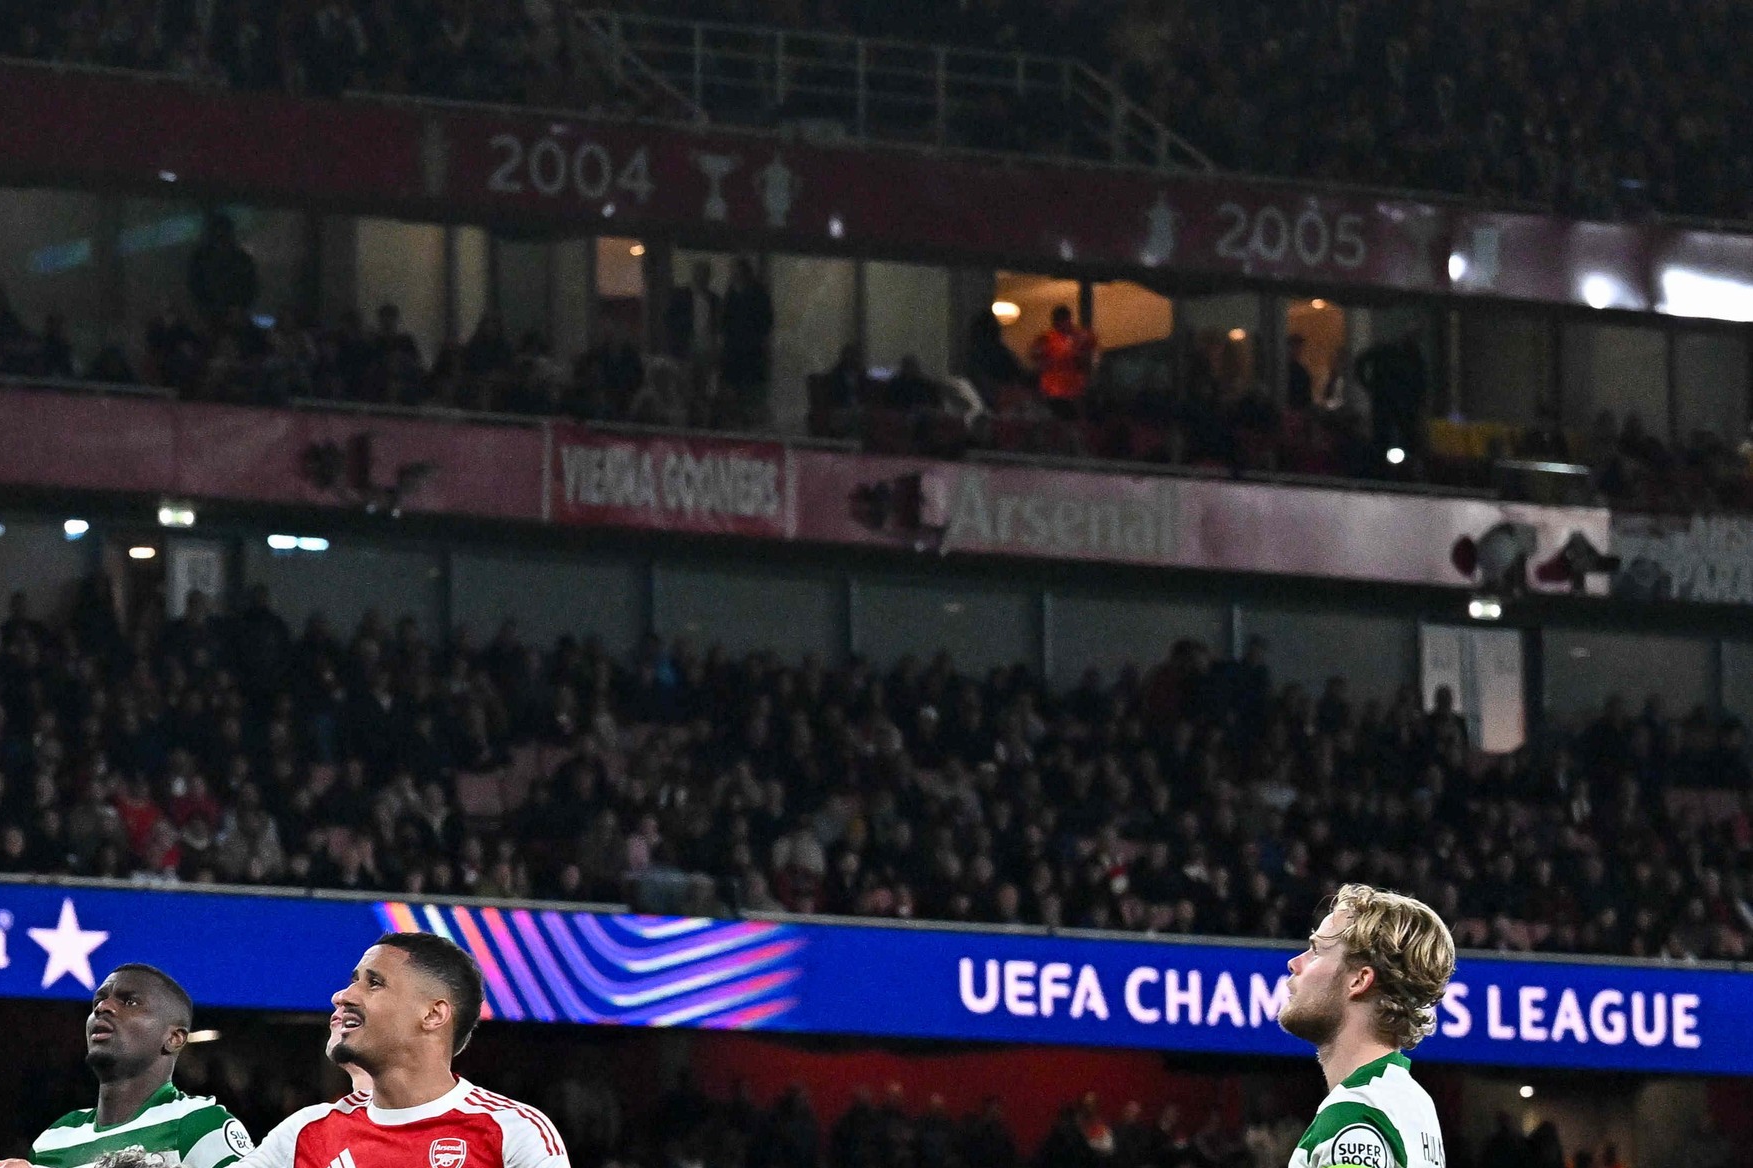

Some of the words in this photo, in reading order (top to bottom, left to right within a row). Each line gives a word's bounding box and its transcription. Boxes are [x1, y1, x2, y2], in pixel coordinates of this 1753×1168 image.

[486, 134, 656, 203] 2004
[1214, 202, 1368, 268] 2005
[942, 468, 1180, 558] Arsenal
[958, 956, 1110, 1021] UEFA
[1123, 965, 1473, 1038] CHAMS
[1486, 984, 1702, 1049] LEAGUE
[1338, 1143, 1381, 1158] SUPER
